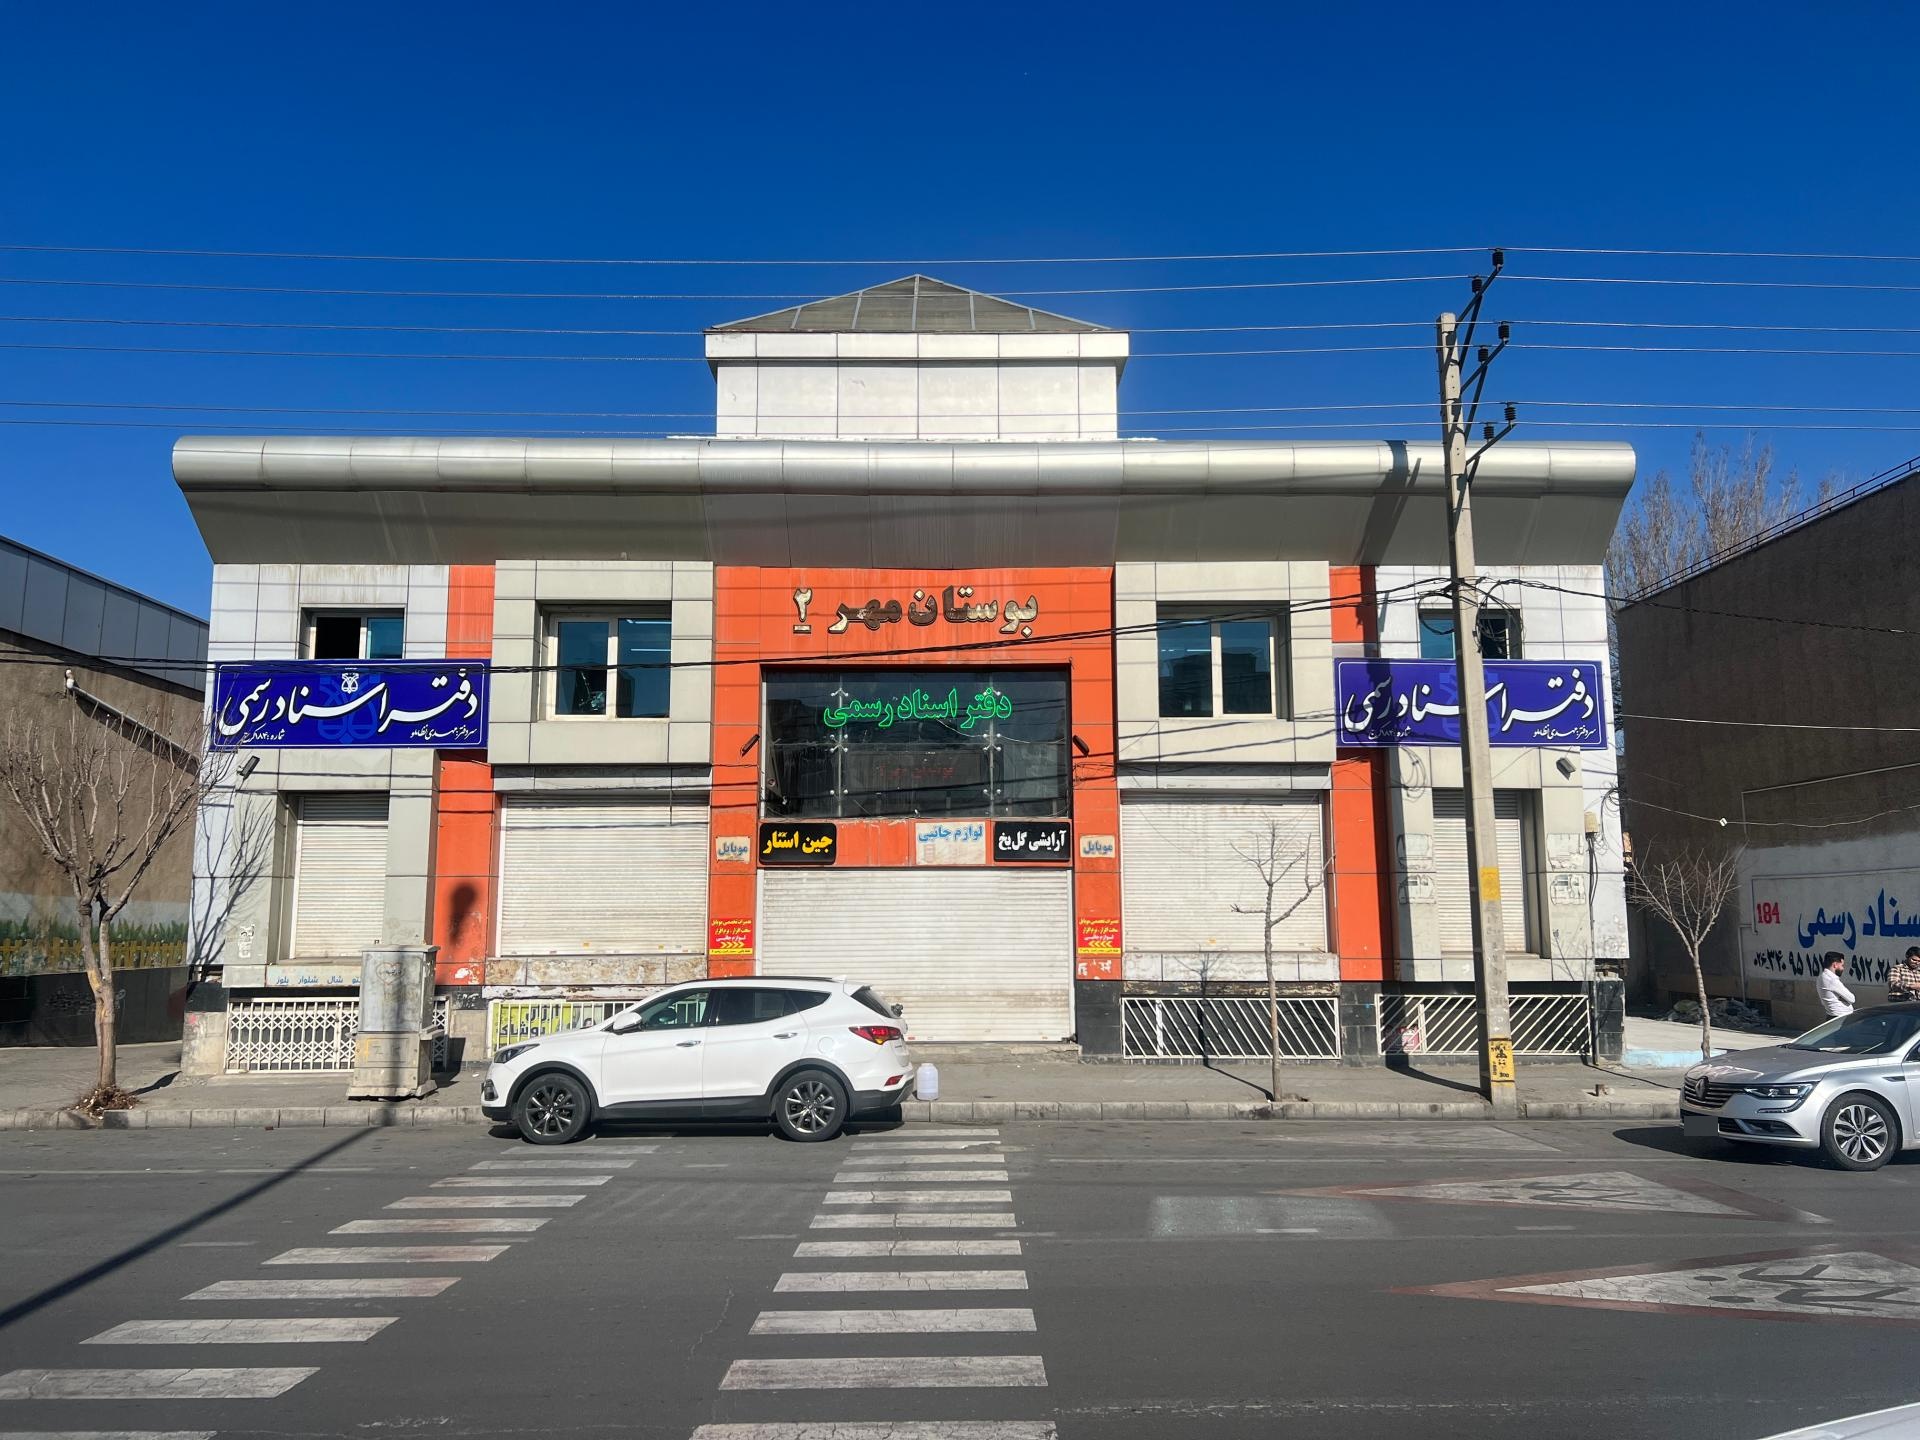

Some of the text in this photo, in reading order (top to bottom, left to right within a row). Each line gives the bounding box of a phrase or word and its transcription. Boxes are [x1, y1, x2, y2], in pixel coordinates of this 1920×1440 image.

[793, 585, 1038, 638] بوستان مهر ۲
[218, 669, 478, 736] دفتر اسناد رسمی
[823, 687, 1012, 729] دفتر اسناد رسمی
[1344, 676, 1392, 733] رسمی
[1502, 668, 1595, 731] دفتر
[762, 830, 833, 854] جین استار
[918, 823, 984, 842] لوازم جانبی
[1028, 830, 1066, 852] آرایشی
[1082, 840, 1114, 856] موبایل
[718, 842, 748, 857] موبایل
[1756, 900, 1780, 924] 184
[1798, 888, 1920, 950] سناد رسمی
